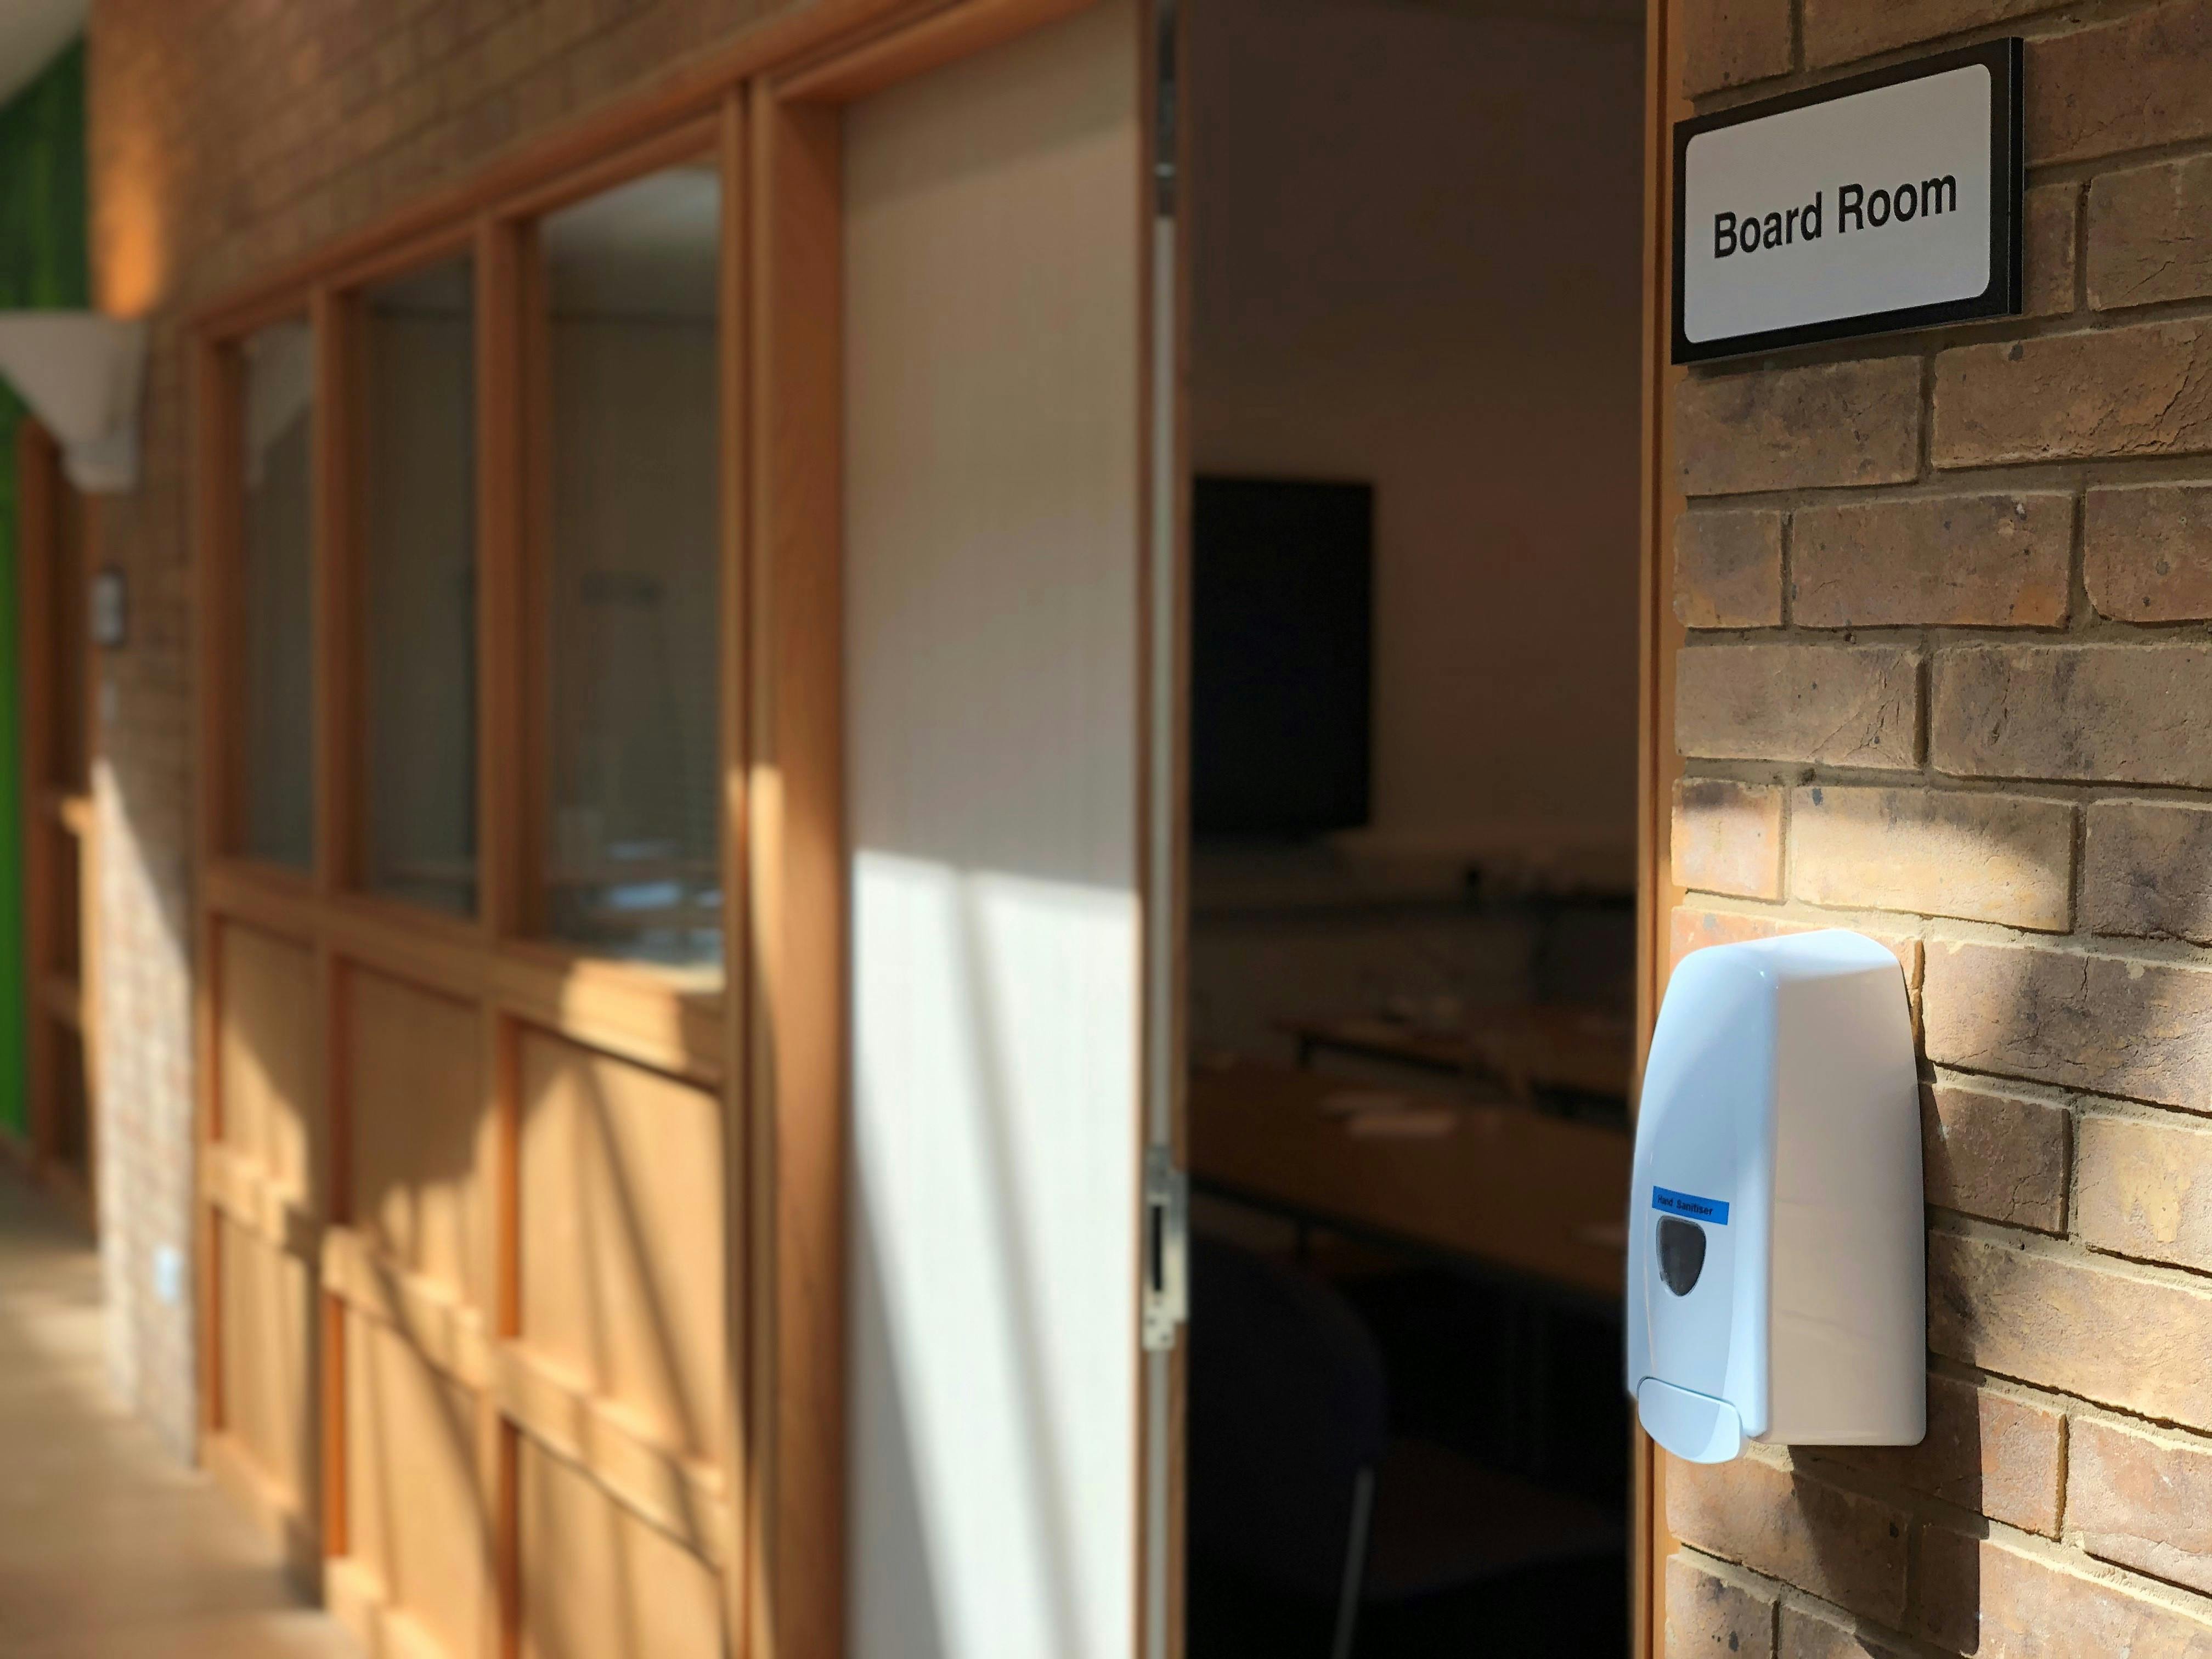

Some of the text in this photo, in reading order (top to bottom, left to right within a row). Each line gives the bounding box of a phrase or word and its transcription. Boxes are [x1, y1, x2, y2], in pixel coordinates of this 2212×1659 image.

[1714, 174, 1957, 258] Board Room
[1657, 1194, 1713, 1215] Hand Sanitiser
